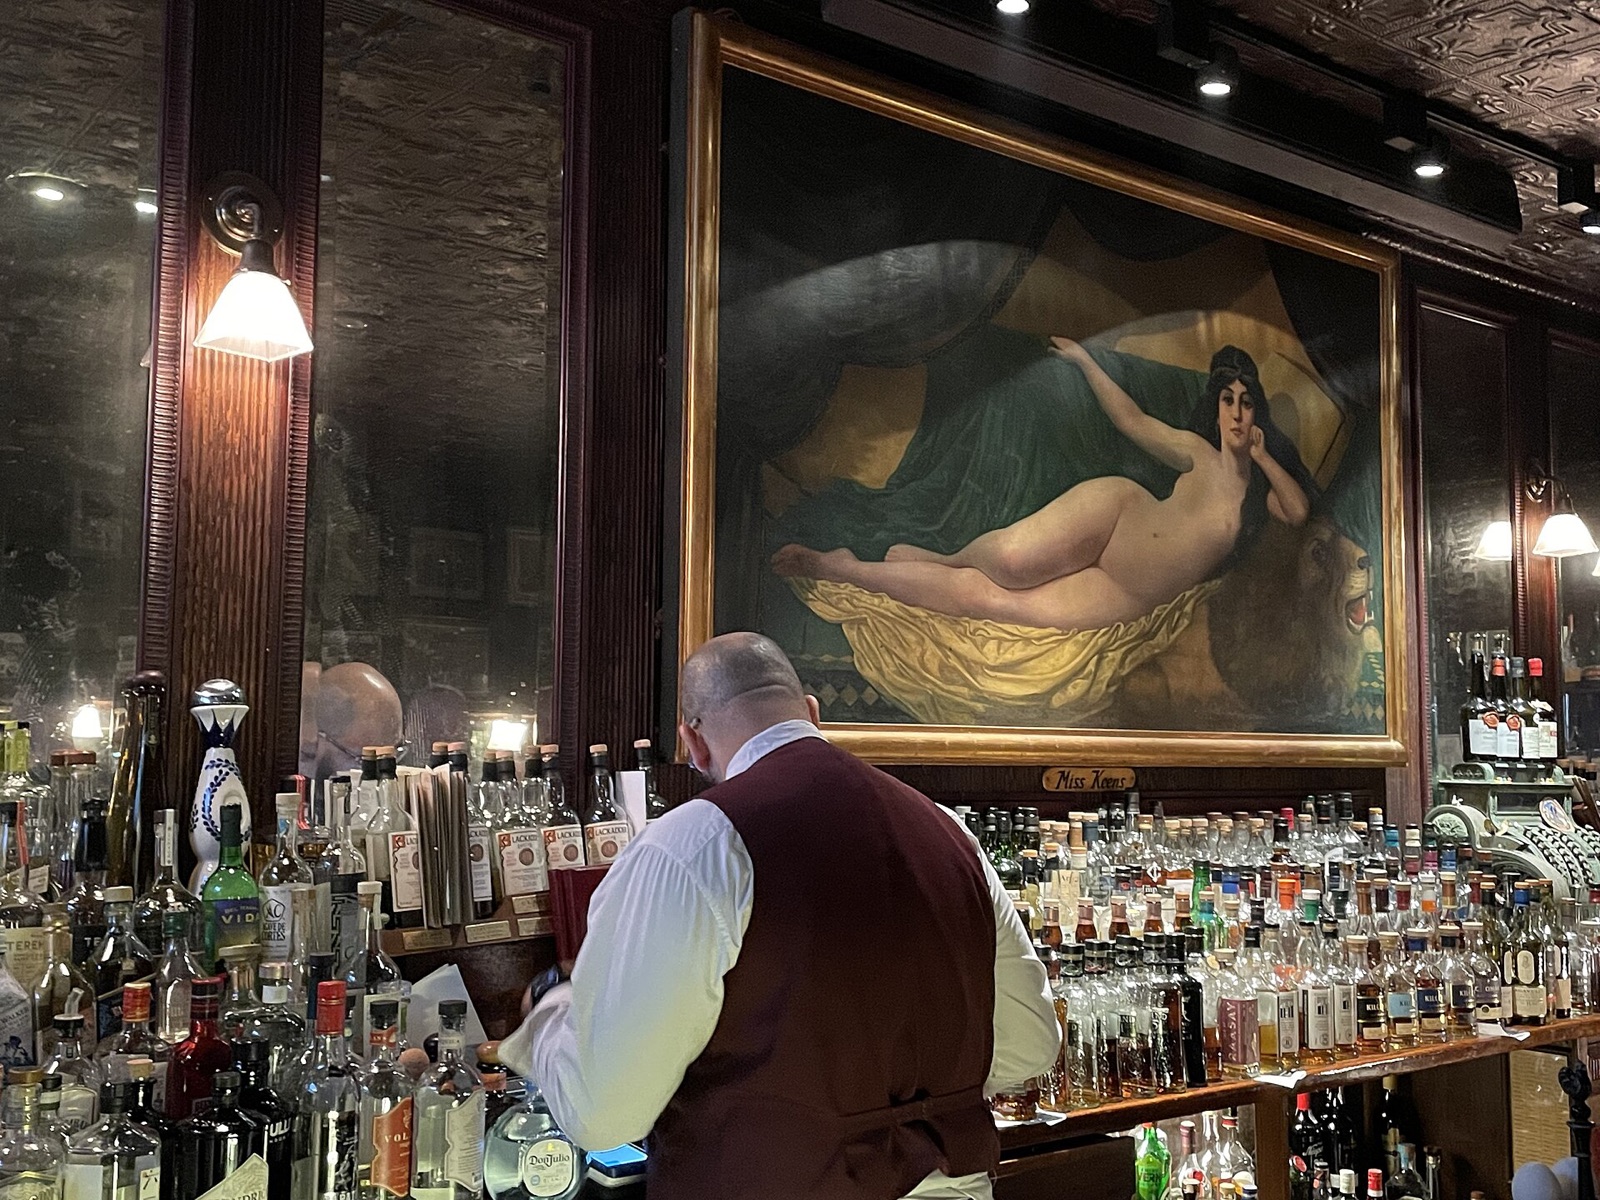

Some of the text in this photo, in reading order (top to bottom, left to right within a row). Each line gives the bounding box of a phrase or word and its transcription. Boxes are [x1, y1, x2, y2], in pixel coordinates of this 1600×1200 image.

[1055, 770, 1127, 790] Miss Keens
[1226, 1001, 1238, 1061] RAASAY
[528, 1153, 570, 1168] Don Julio
